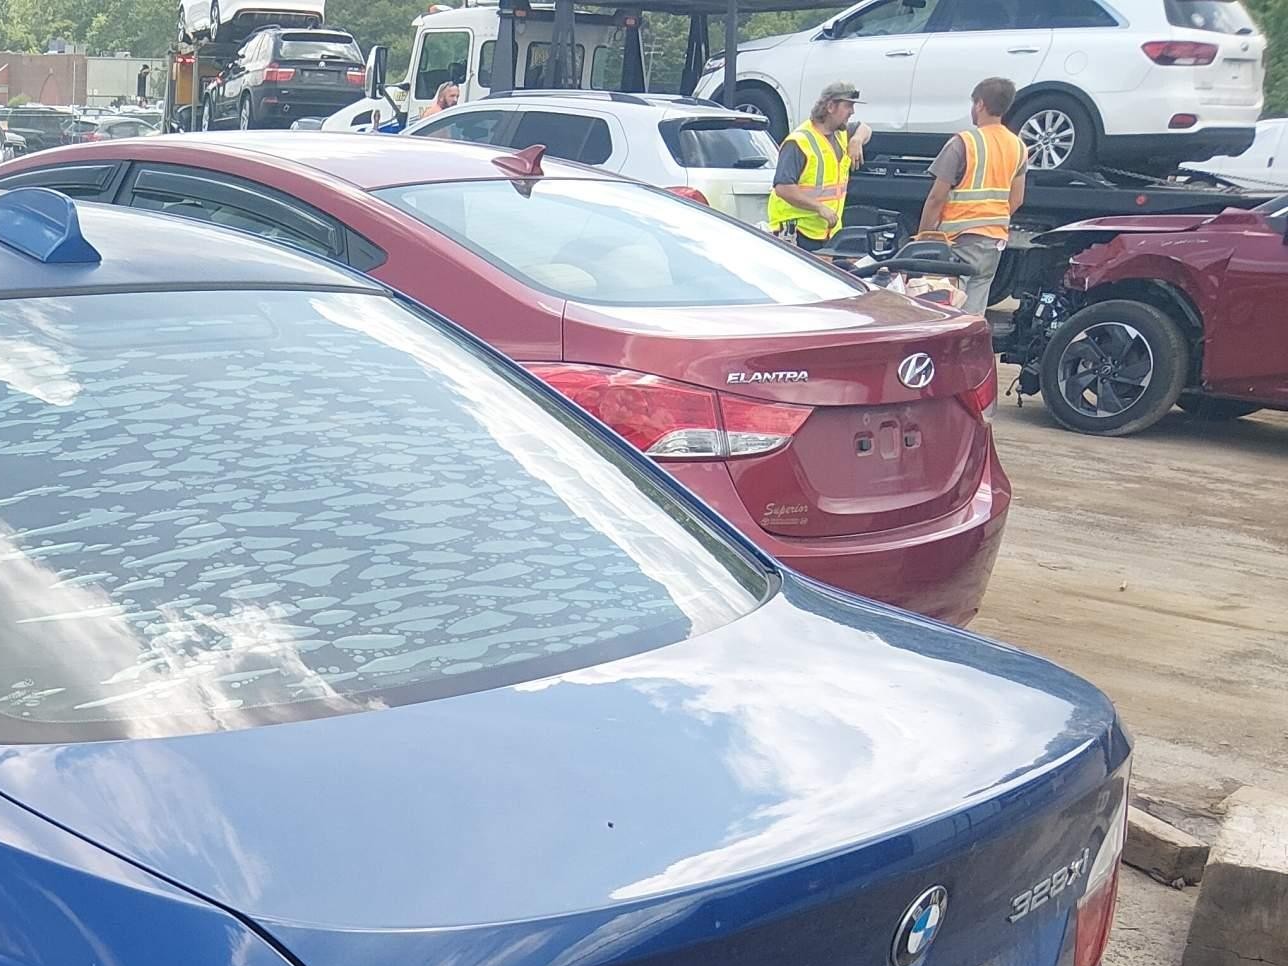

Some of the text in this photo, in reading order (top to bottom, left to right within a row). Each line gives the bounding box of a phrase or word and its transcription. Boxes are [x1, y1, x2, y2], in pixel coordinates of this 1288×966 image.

[726, 370, 809, 385] ELANTRA
[763, 502, 809, 518] Superior
[1008, 847, 1090, 923] 328xi
